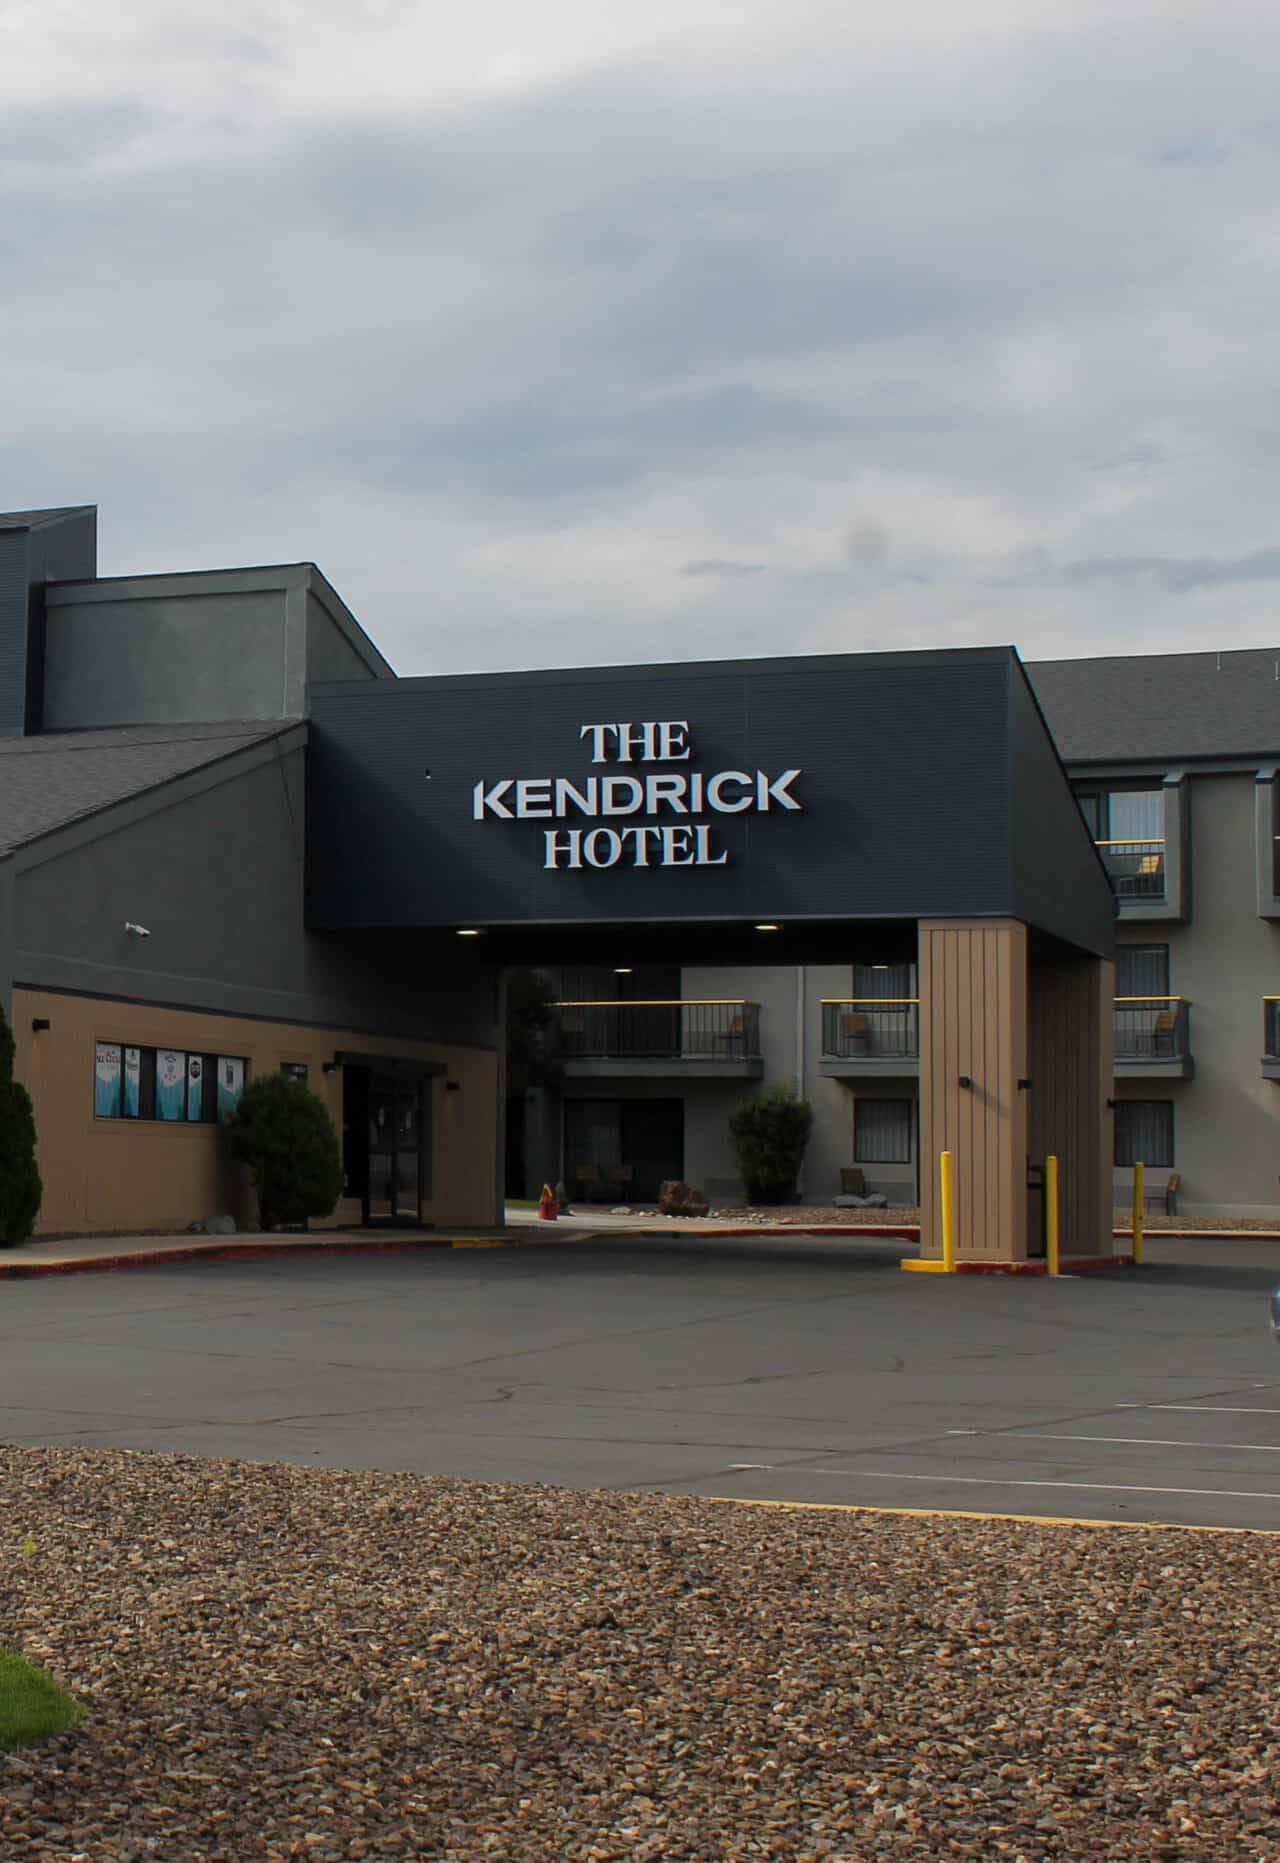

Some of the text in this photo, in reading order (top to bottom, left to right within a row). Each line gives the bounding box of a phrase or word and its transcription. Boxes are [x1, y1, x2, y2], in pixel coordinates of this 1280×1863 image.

[579, 719, 690, 764] THE
[472, 769, 803, 820] KENDRICK
[543, 824, 728, 870] HOTEL
